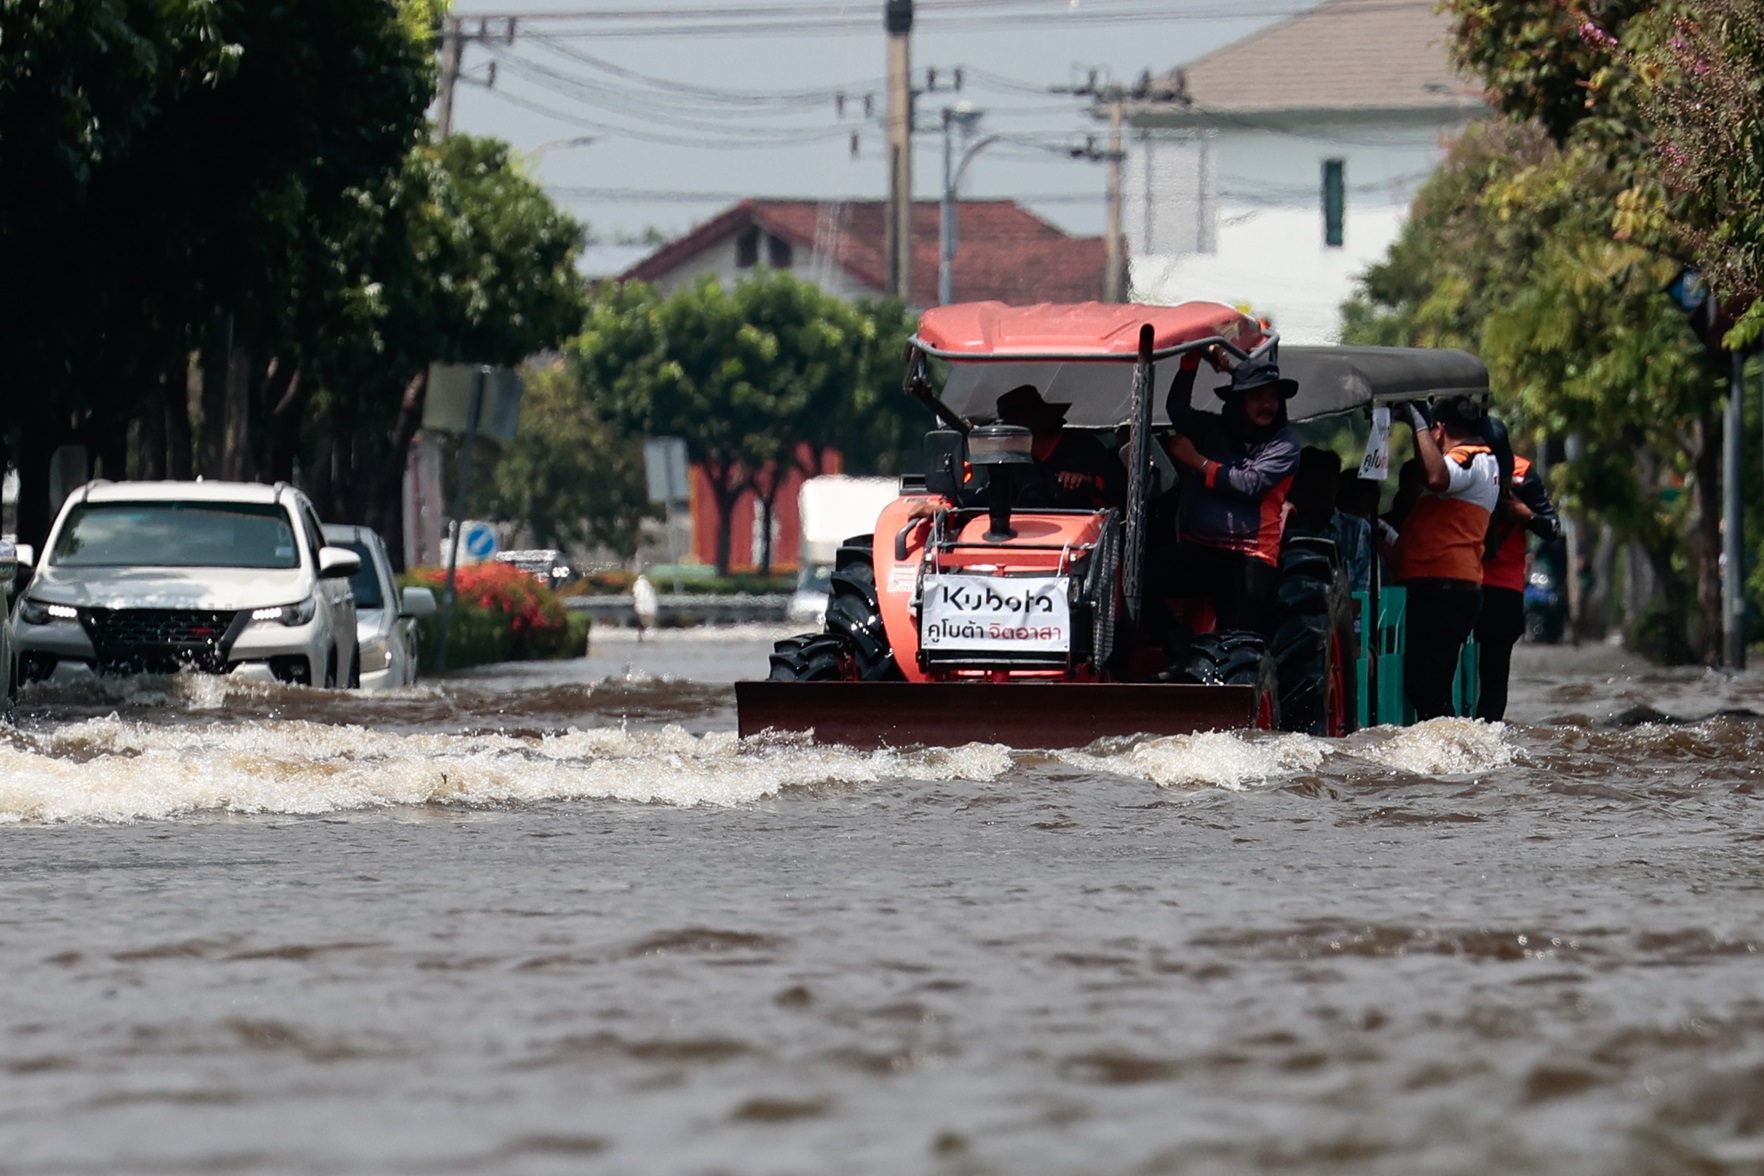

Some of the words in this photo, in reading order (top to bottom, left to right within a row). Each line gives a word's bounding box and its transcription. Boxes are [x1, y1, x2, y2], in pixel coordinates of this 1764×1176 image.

[943, 586, 1053, 613] Kubota
[928, 619, 984, 643] คูโบต้า
[989, 622, 1062, 641] จิตอาสา
